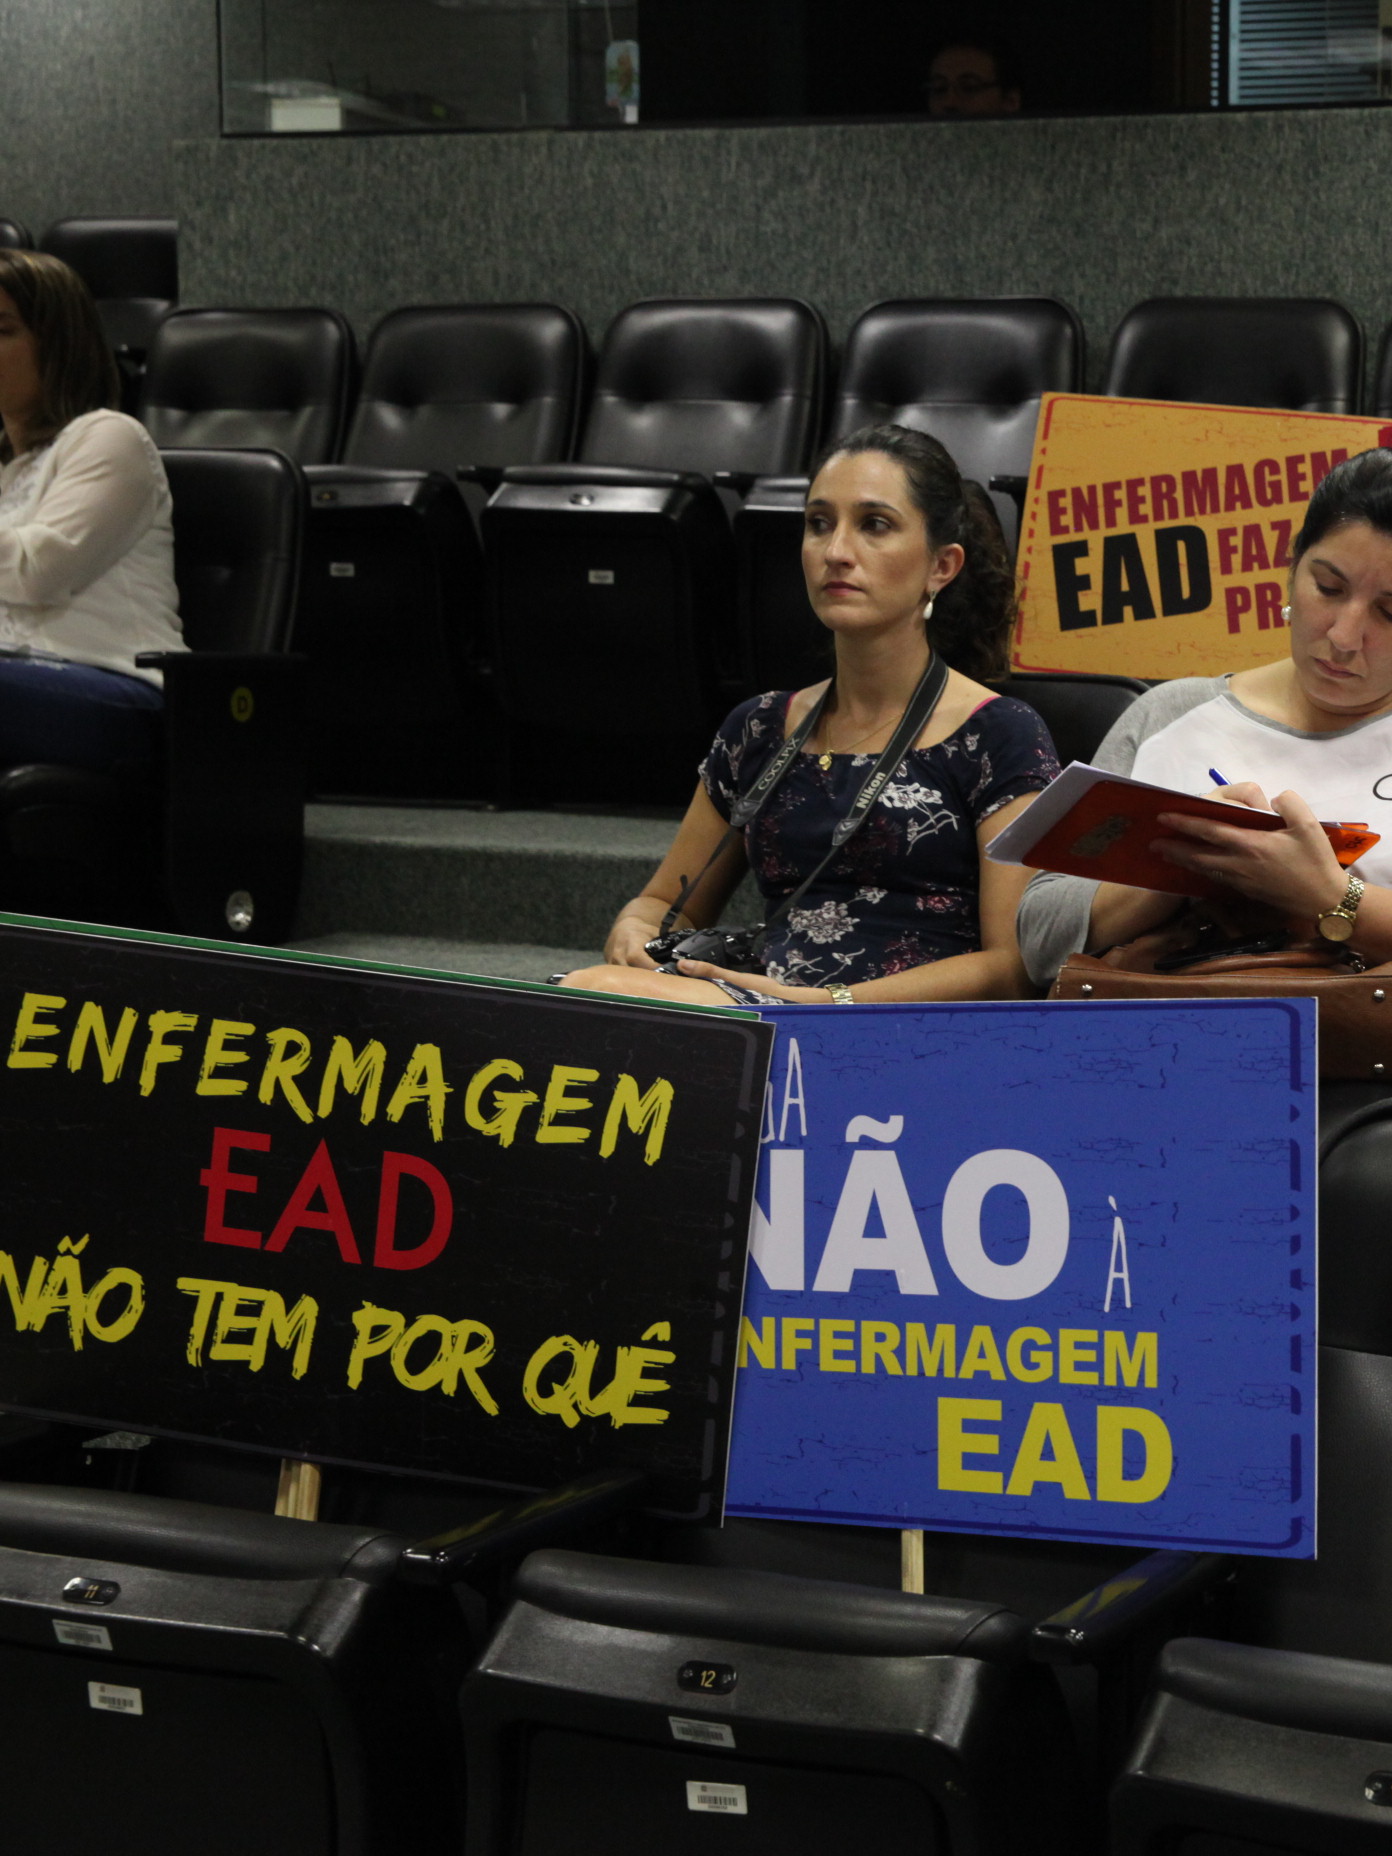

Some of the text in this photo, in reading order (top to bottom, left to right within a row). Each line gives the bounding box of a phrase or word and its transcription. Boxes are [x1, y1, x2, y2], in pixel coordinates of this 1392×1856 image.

[1052, 525, 1212, 632] EAD
[1224, 581, 1291, 634] PR
[758, 737, 800, 790] COOLPIX
[856, 771, 887, 809] Nikon
[7, 992, 675, 1167] ENFERMAGEM
[200, 1126, 454, 1271] EAD
[745, 1114, 1071, 1301] NÃO
[0, 1233, 677, 1429] NÃO TEM POR QUÊ
[938, 1397, 1173, 1504] EAD
[700, 1670, 716, 1688] 12
